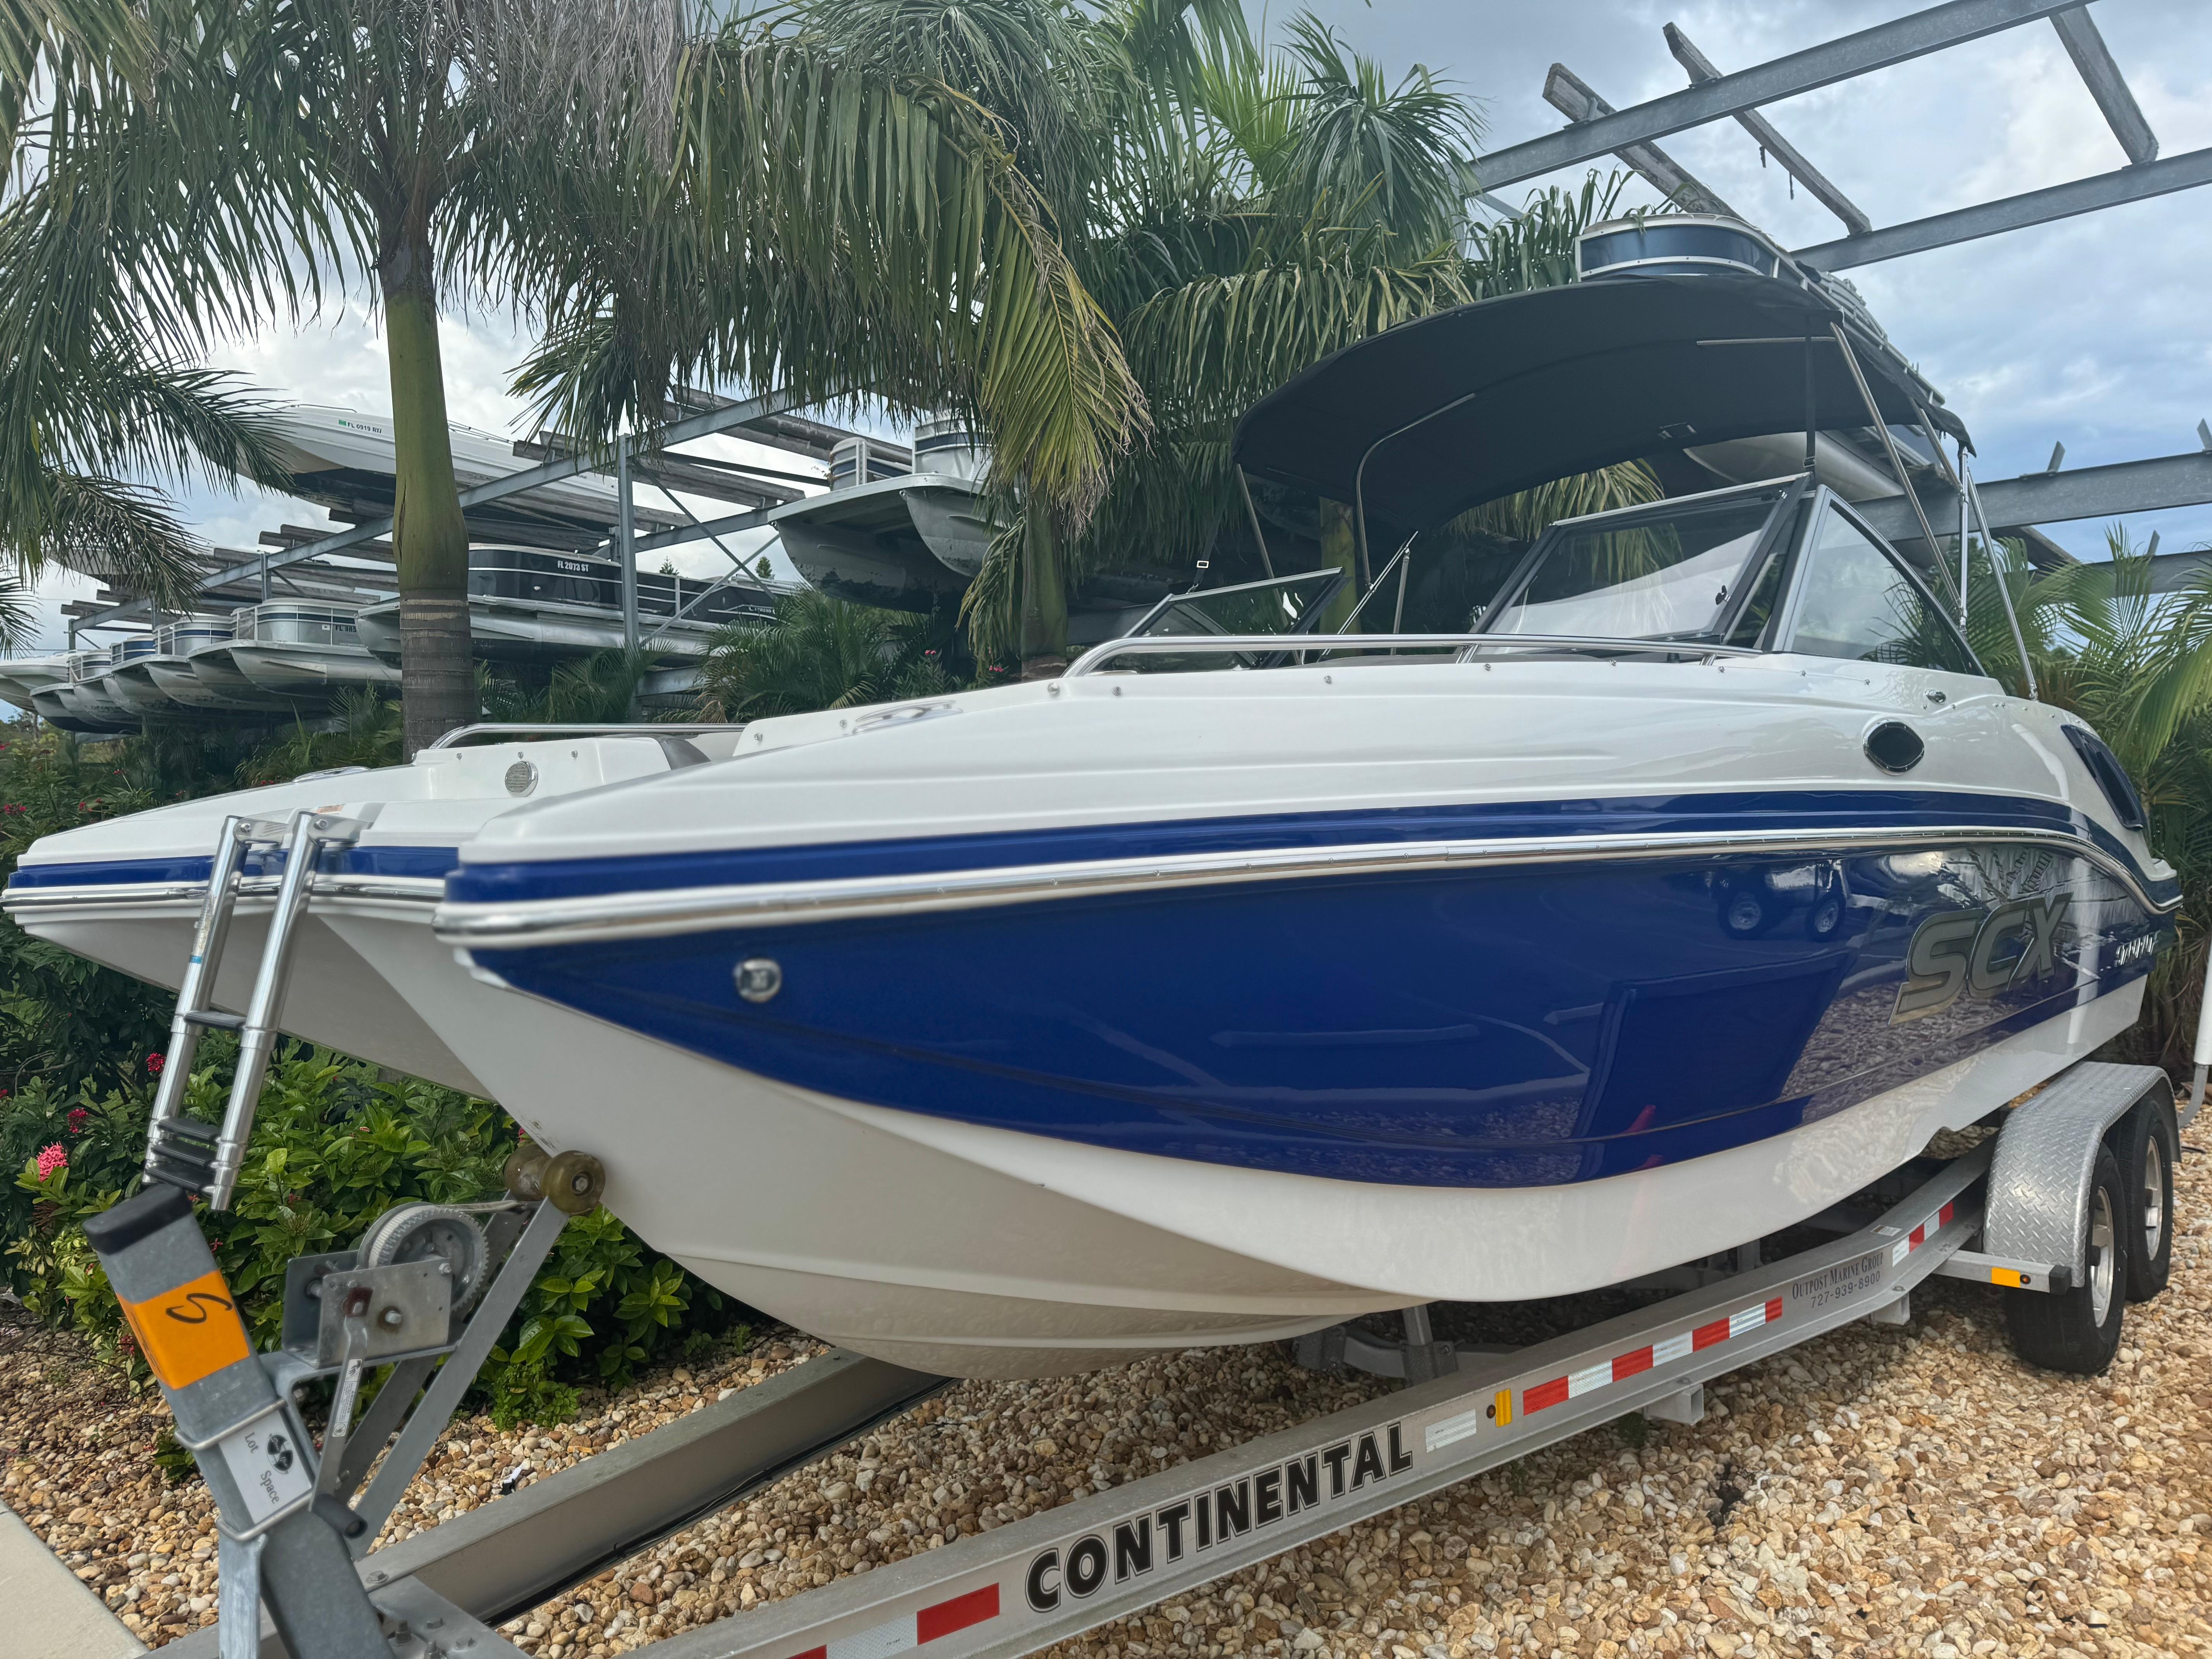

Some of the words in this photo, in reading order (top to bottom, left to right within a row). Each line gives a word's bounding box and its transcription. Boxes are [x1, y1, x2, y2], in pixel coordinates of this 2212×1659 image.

[558, 560, 564, 568] FL
[565, 562, 580, 571] 2073
[1888, 892, 2074, 1026] SCX
[1792, 1274, 1828, 1299] OUTPOST
[1830, 1263, 1859, 1285] MARINE
[1862, 1252, 1883, 1273] GROUP
[1811, 1271, 1880, 1308] 727-939-8900
[245, 1432, 259, 1453] Lot
[260, 1470, 279, 1504] Space
[1025, 1422, 1413, 1613] CONTINENTAL
